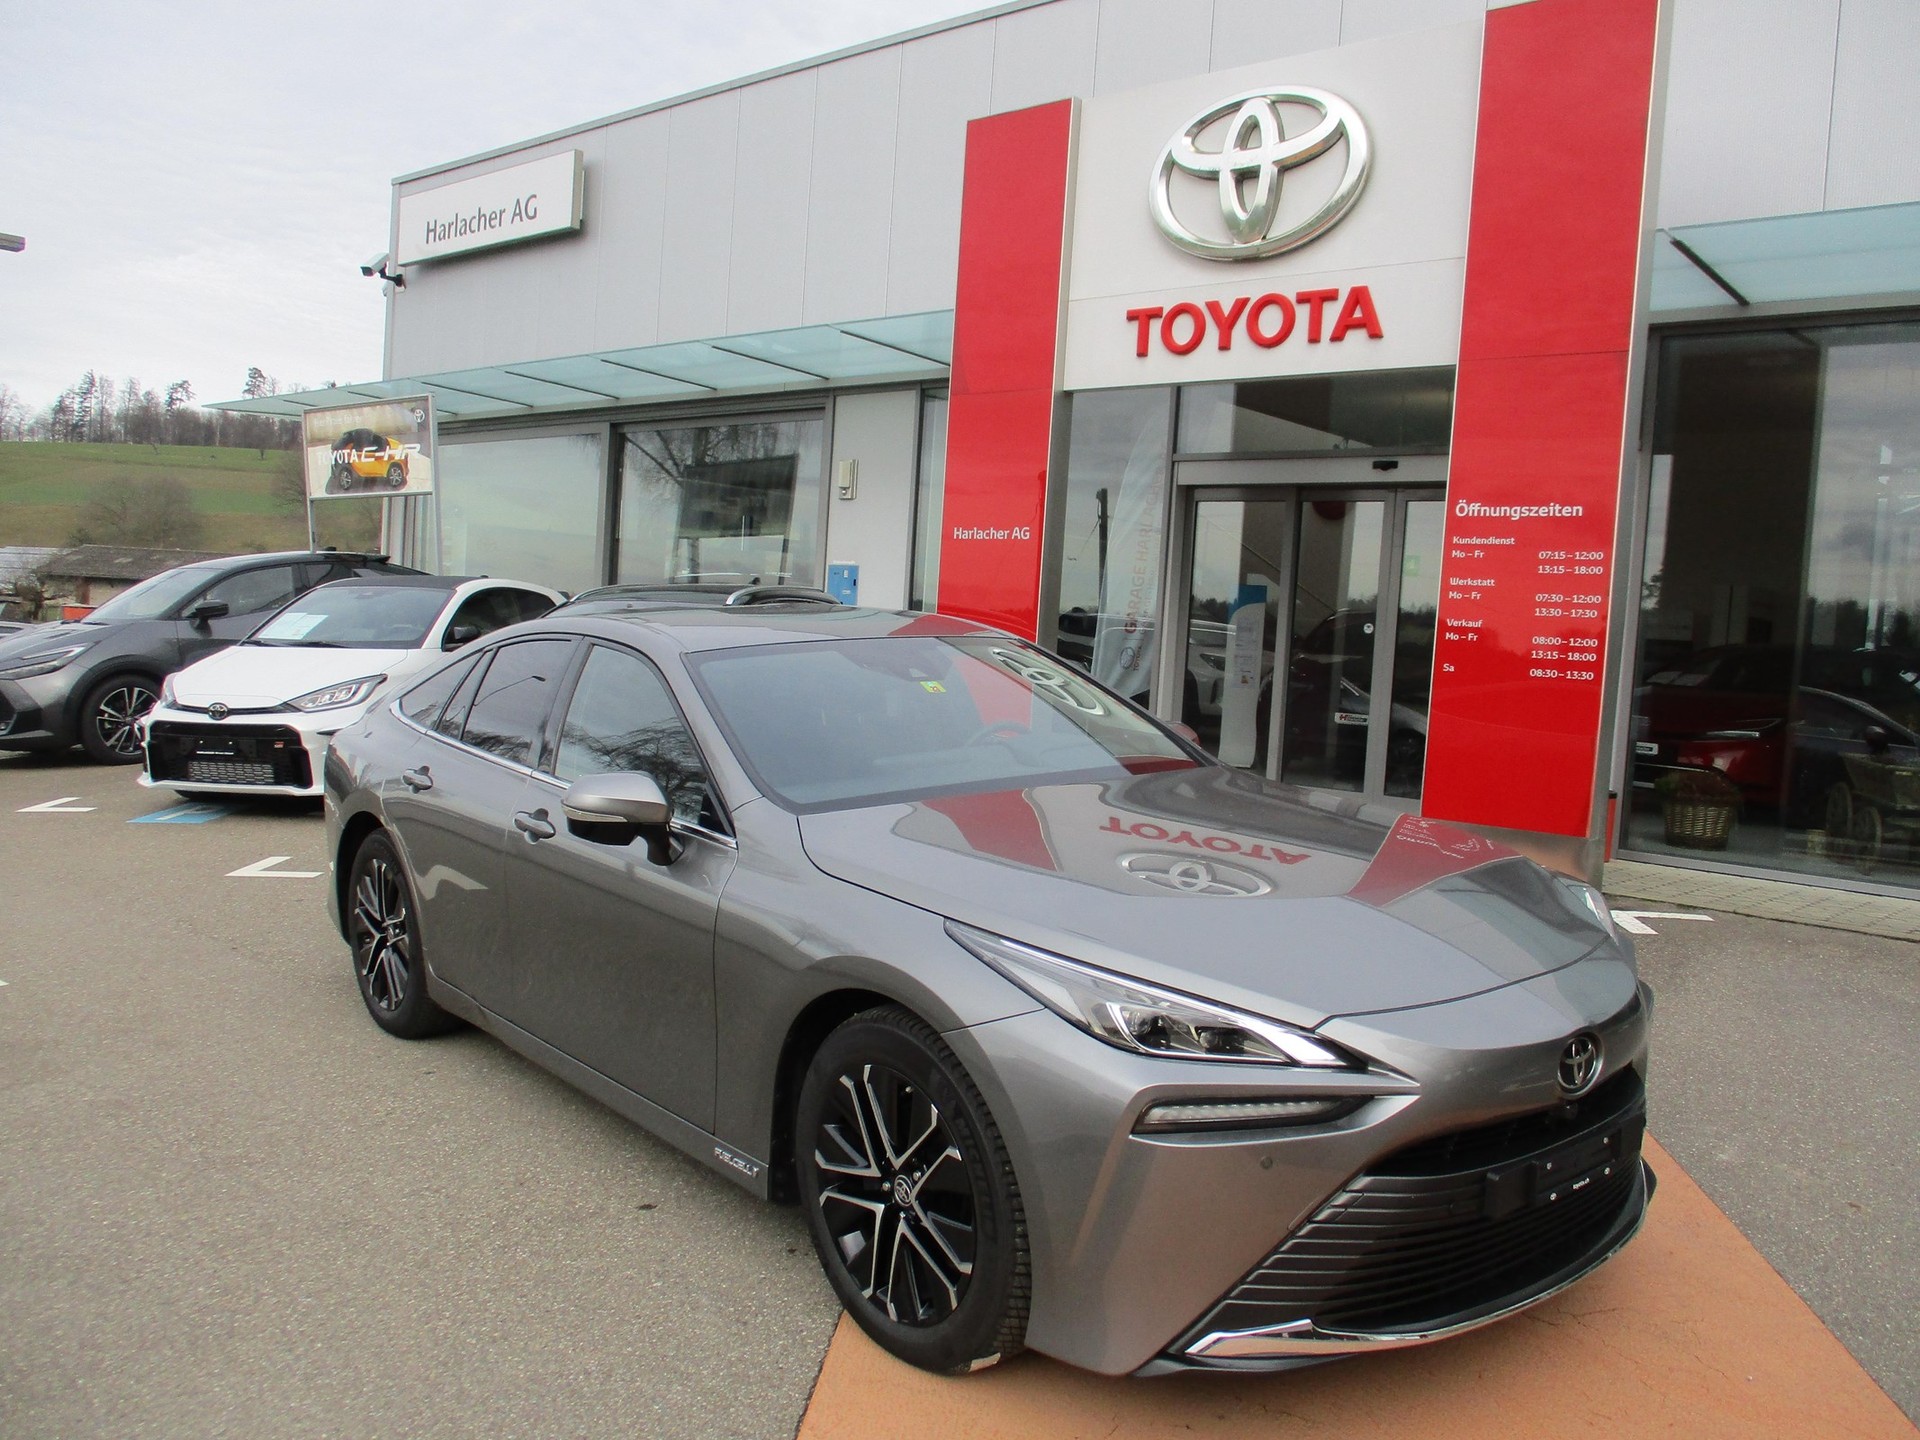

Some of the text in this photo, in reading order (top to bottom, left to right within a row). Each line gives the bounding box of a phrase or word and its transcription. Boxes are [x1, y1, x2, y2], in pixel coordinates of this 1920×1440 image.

[425, 193, 538, 245] Harlacher AG
[1126, 285, 1384, 357] TOYOTA
[360, 443, 421, 463] C-HR
[1455, 499, 1583, 520] Öffnungszeiten
[953, 526, 1030, 539] Harlacher AG
[1452, 536, 1515, 545] Kundendienst
[1452, 550, 1466, 558] Mo
[1474, 550, 1485, 558] Fr
[1538, 551, 1566, 560] 07:15
[1574, 552, 1604, 560] 12:00
[1537, 565, 1565, 574] 13:15
[1574, 566, 1603, 575] 18:00
[1450, 577, 1495, 587] Werkstatt
[1124, 564, 1147, 635] GARAGE
[1448, 591, 1462, 600] Mo
[1471, 591, 1482, 600] Fr
[1535, 594, 1563, 603] 07:30
[1572, 594, 1602, 604] 12:00
[1534, 608, 1562, 617] 13:30
[1570, 609, 1598, 618] 17:30
[1446, 618, 1483, 628] Verkauf
[1445, 632, 1459, 641] Mo
[1468, 633, 1478, 641] Fr
[1532, 636, 1561, 646] 08:00
[1569, 638, 1598, 647] 12:00
[1531, 650, 1559, 659] 13:15
[1567, 652, 1597, 662] 18:00
[1443, 663, 1455, 672] Sa
[1529, 668, 1558, 678] 08:30
[1566, 671, 1594, 680] 13:30
